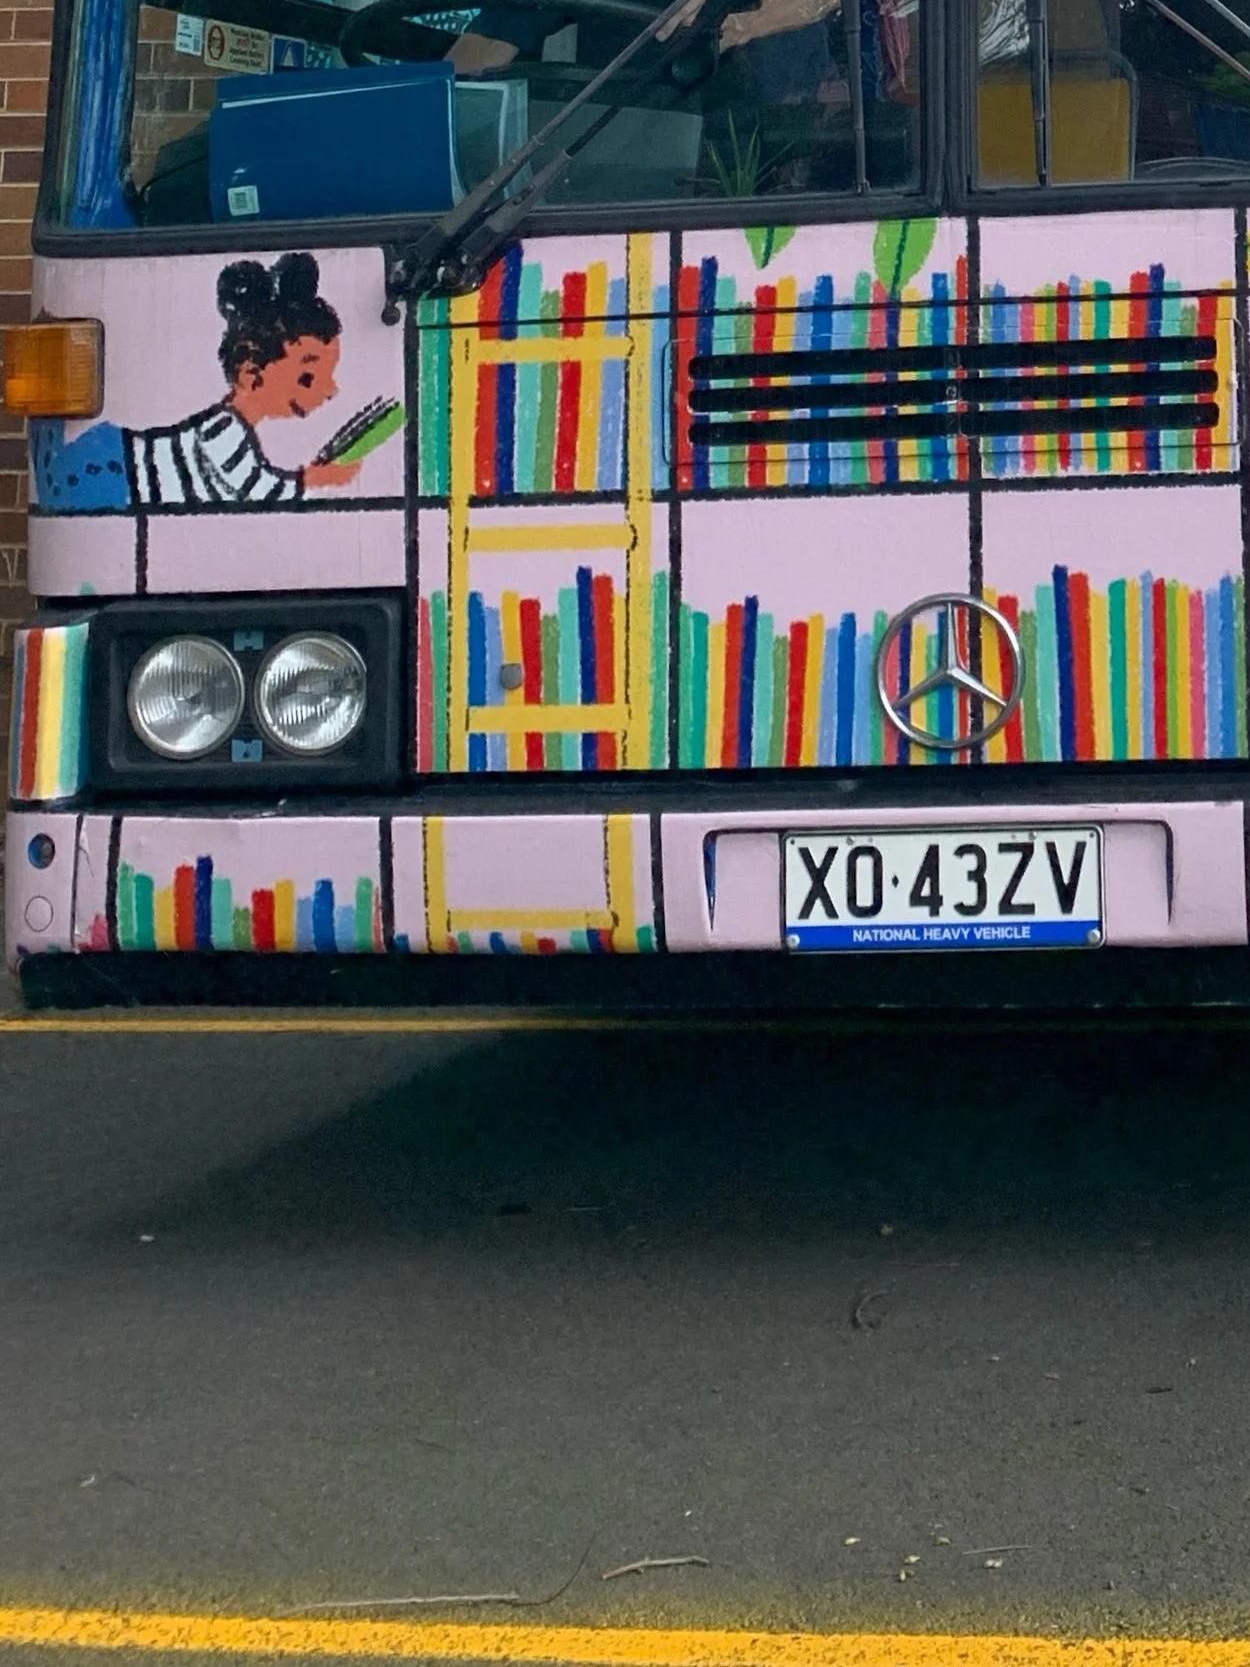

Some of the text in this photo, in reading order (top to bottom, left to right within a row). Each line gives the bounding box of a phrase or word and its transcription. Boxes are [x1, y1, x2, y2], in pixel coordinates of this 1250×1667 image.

[852, 926, 1031, 942] NATIONAL HEAVY VEHICLE
